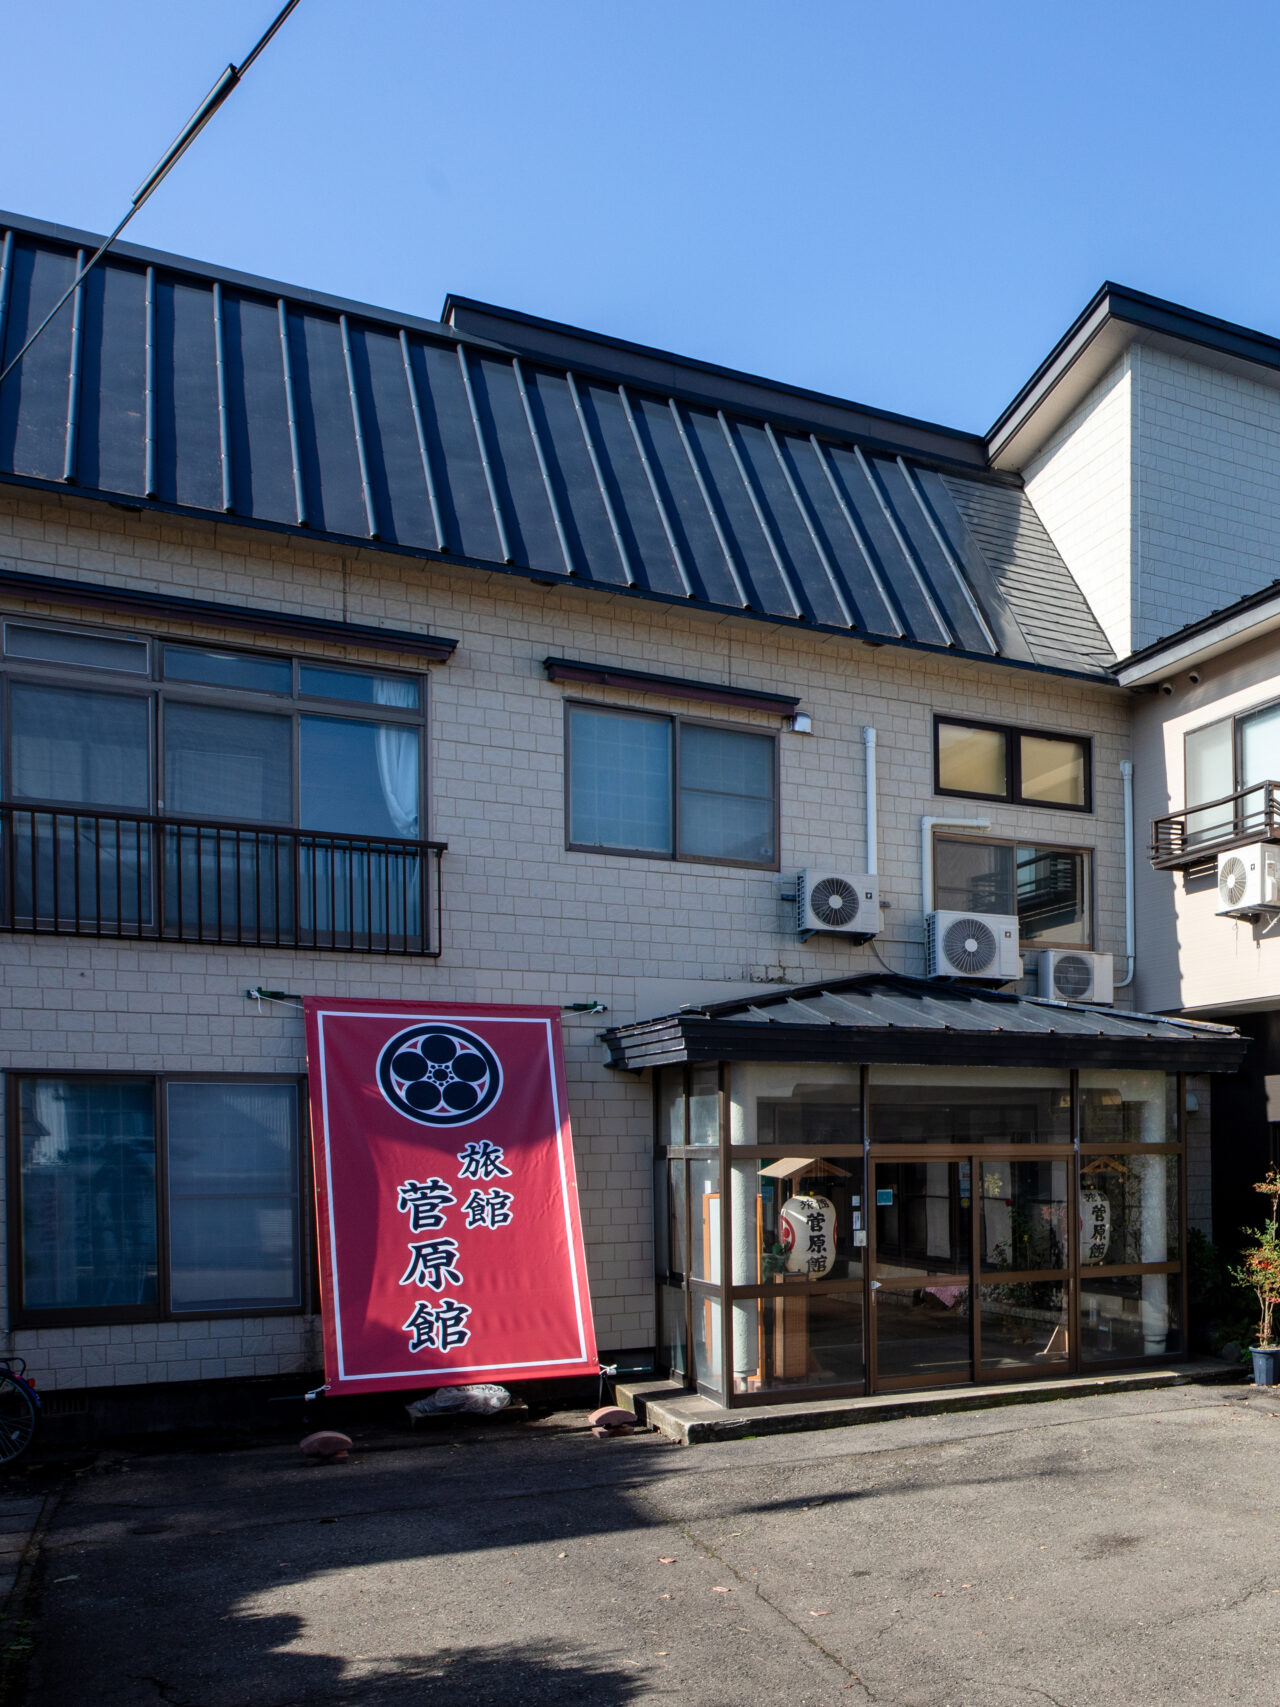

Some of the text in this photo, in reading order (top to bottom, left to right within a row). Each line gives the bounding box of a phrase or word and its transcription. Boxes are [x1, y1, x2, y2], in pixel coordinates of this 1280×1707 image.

[458, 1139, 514, 1229] 旅館
[397, 1178, 472, 1353] 菅原館
[806, 1212, 828, 1273] 菅原館
[1090, 1203, 1107, 1259] 菅原館
